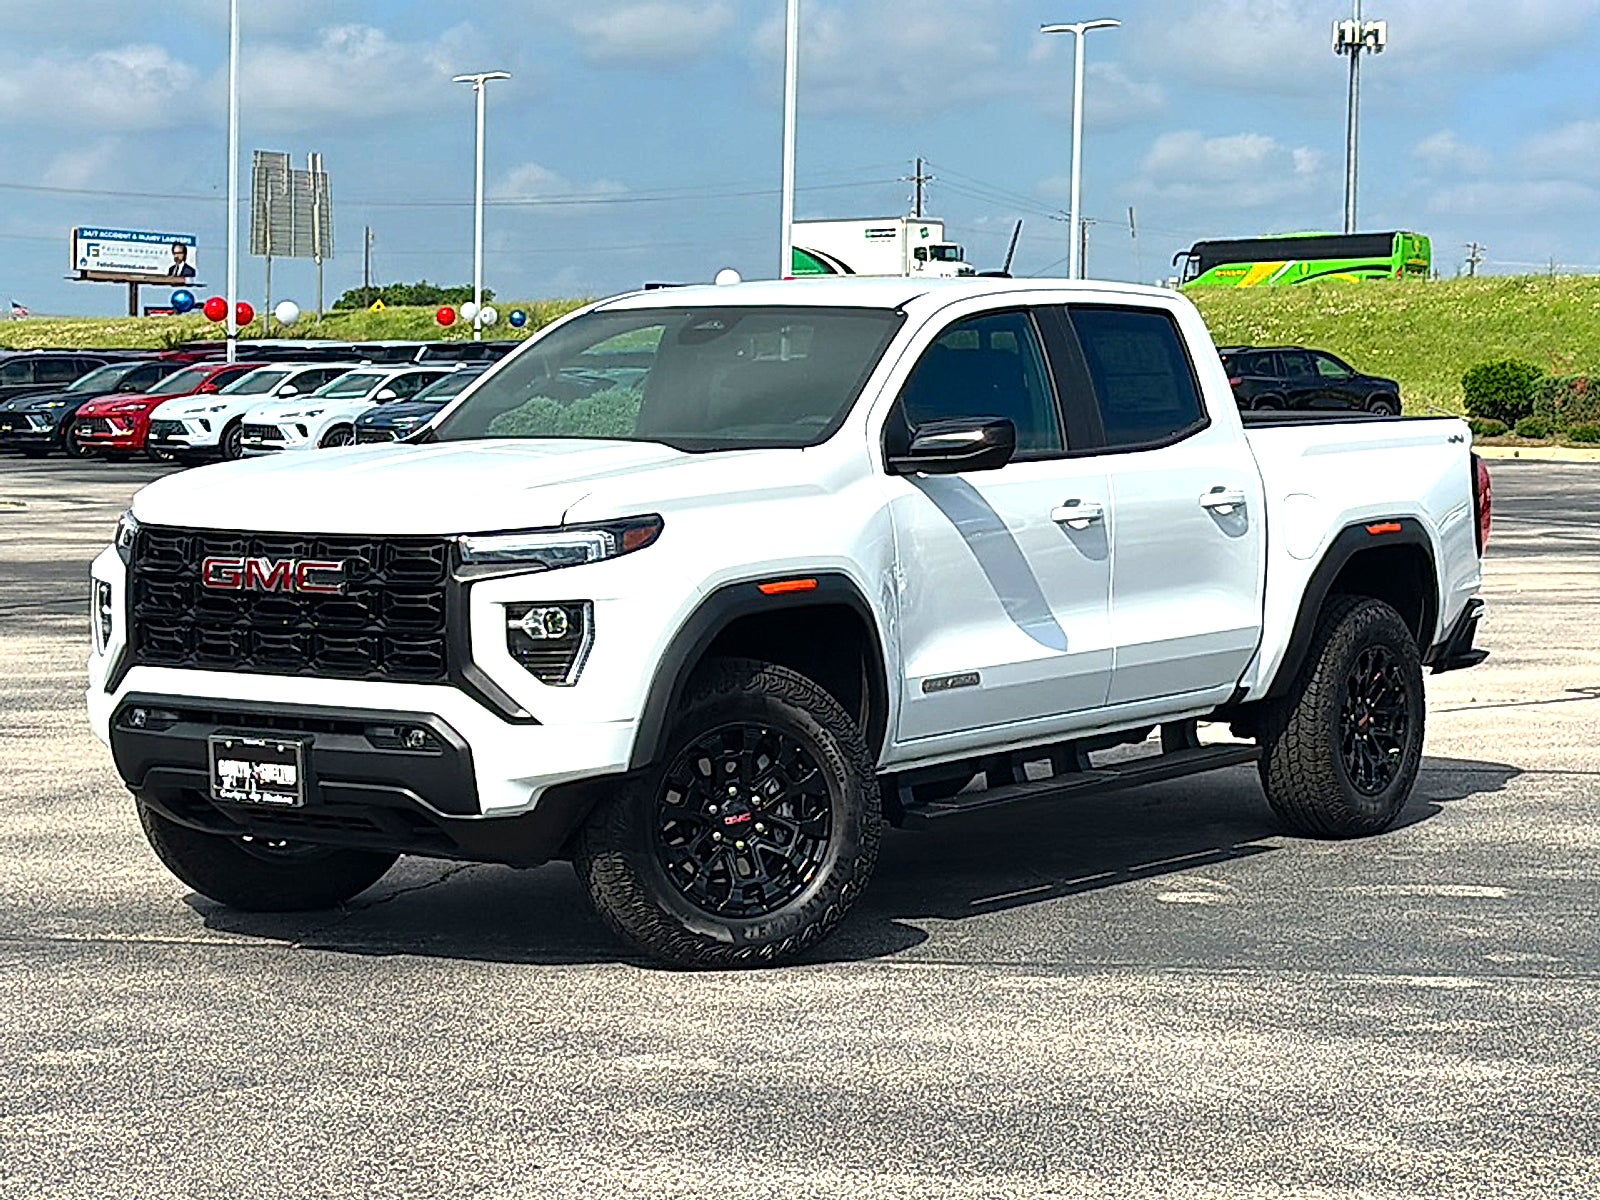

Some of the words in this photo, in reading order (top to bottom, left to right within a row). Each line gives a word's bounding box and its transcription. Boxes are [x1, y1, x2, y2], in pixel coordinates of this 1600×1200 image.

[99, 231, 131, 239] ACCIDENT
[202, 556, 346, 595] GMC
[724, 812, 752, 825] GMC
